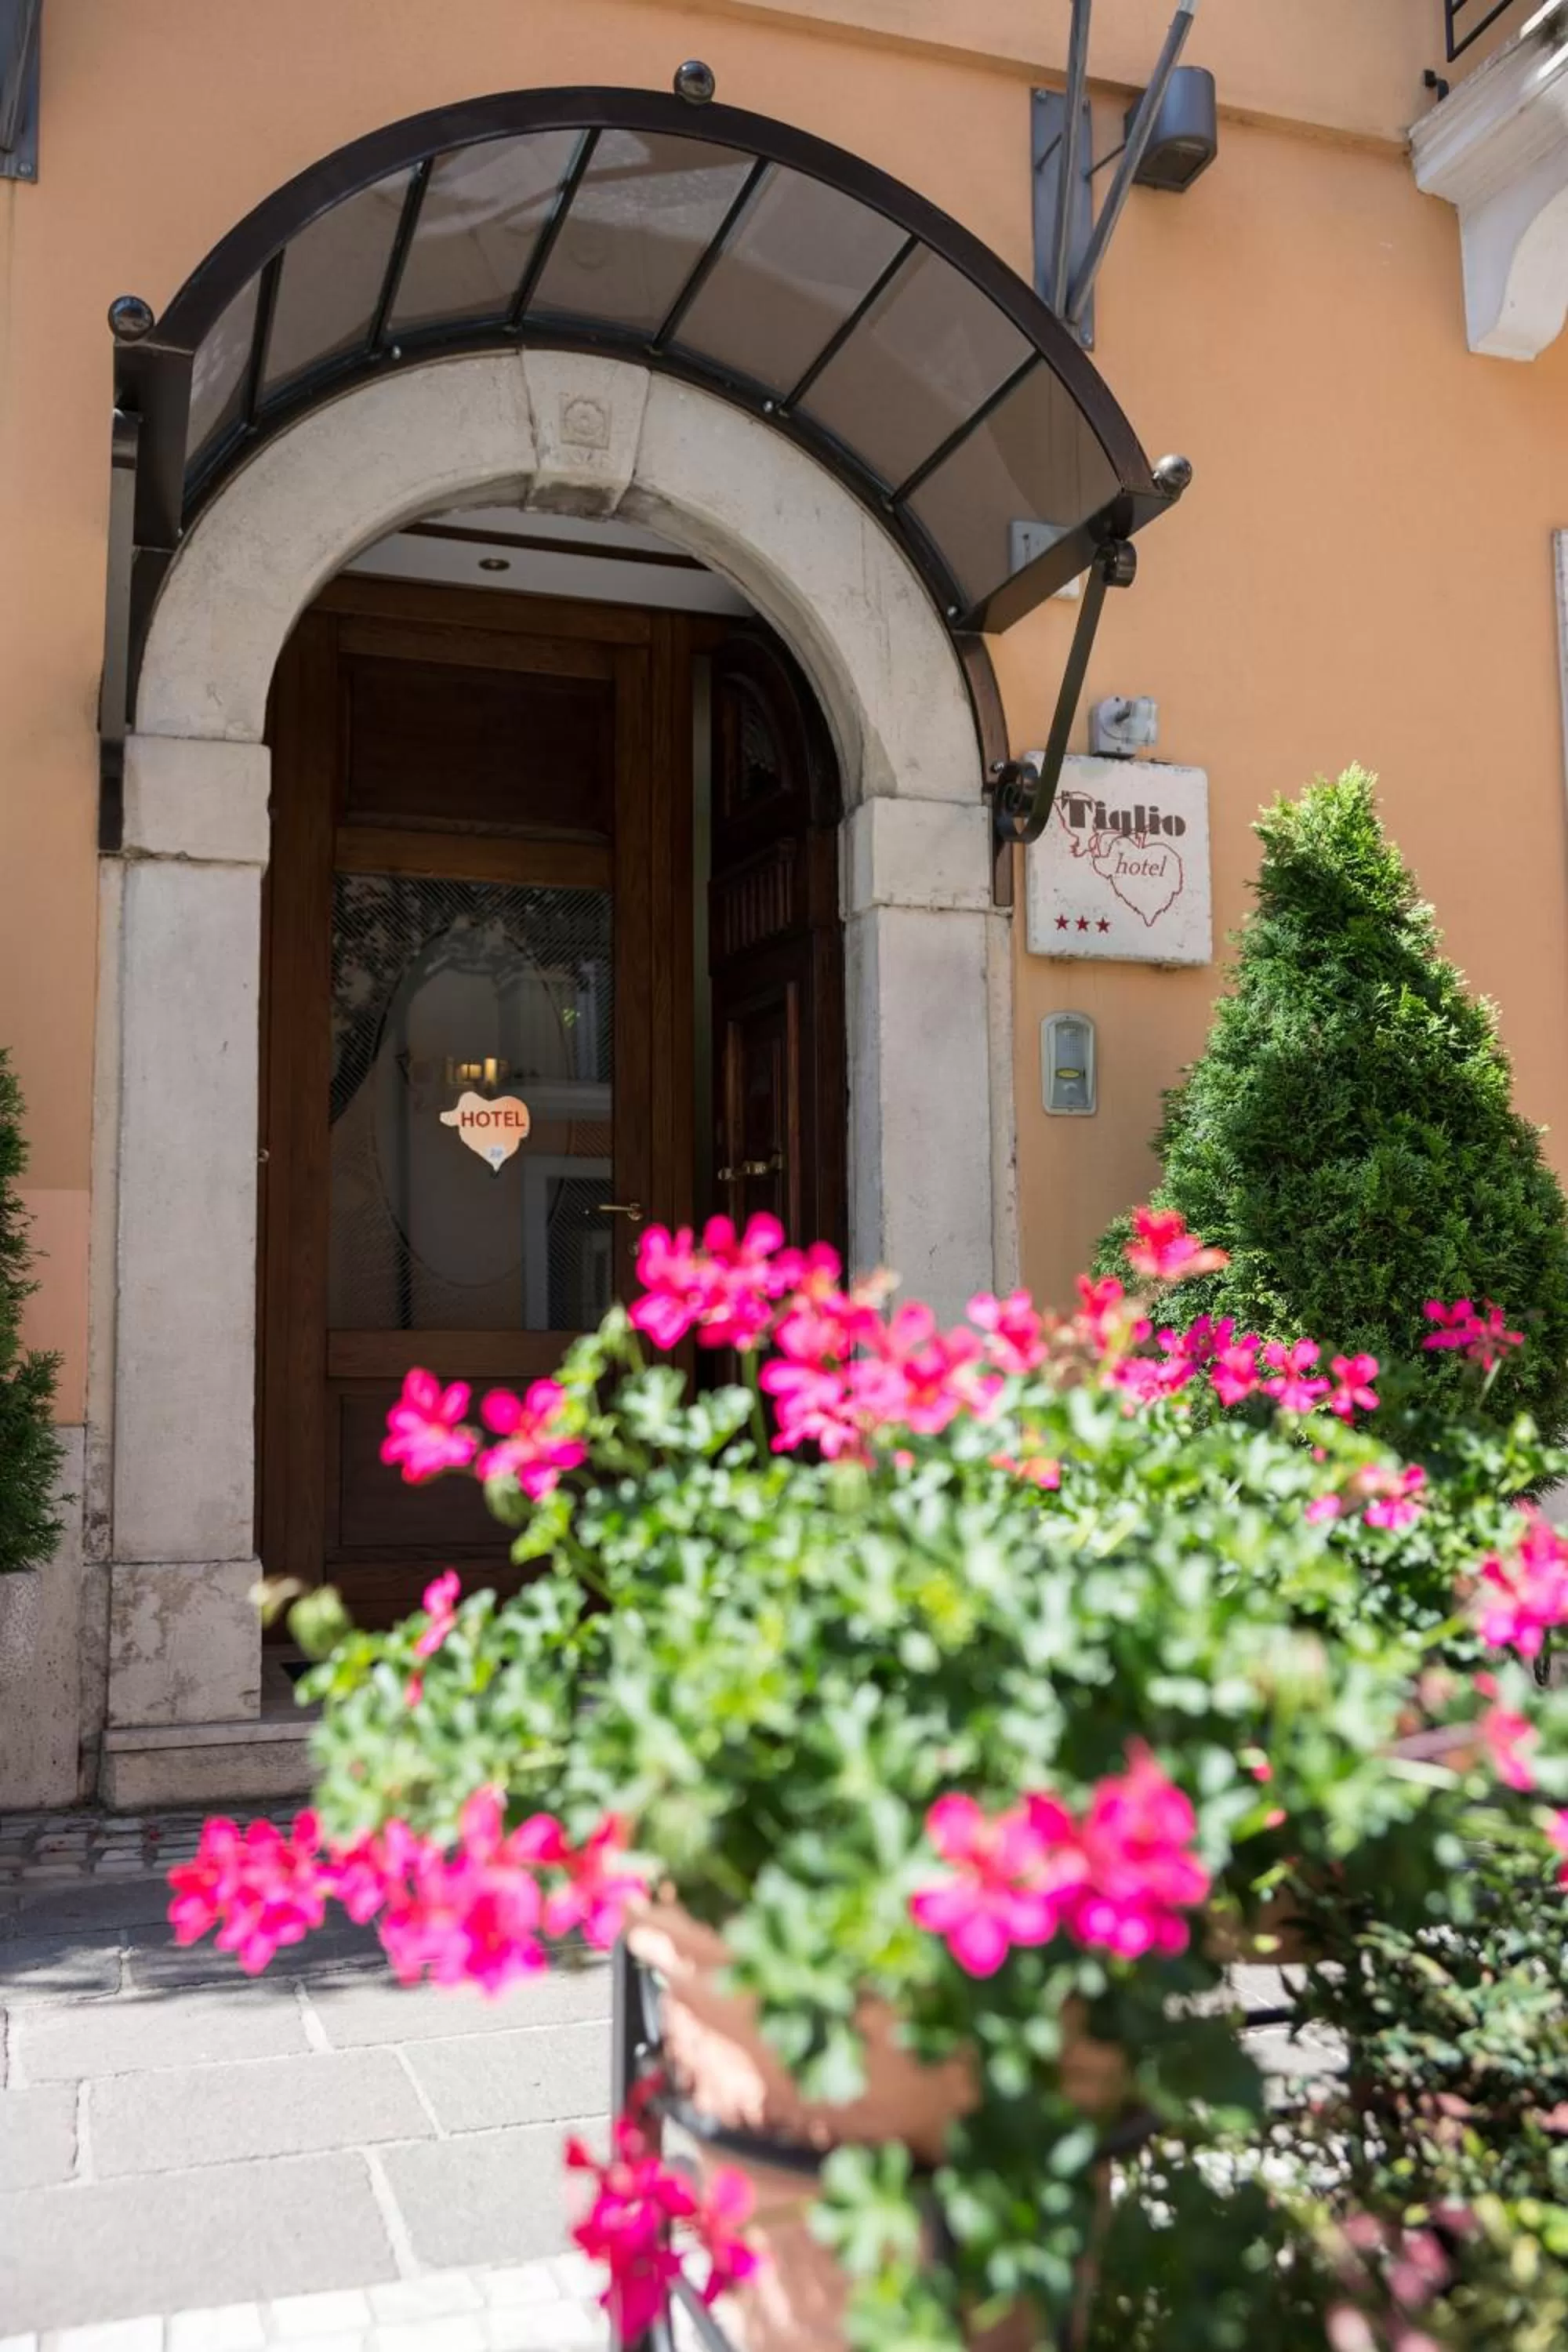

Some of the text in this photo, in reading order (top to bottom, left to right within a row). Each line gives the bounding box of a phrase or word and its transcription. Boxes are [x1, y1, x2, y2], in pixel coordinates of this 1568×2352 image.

[1062, 799, 1185, 837] Tiglio
[1115, 852, 1167, 877] hotel
[461, 1111, 525, 1127] HOTEL
